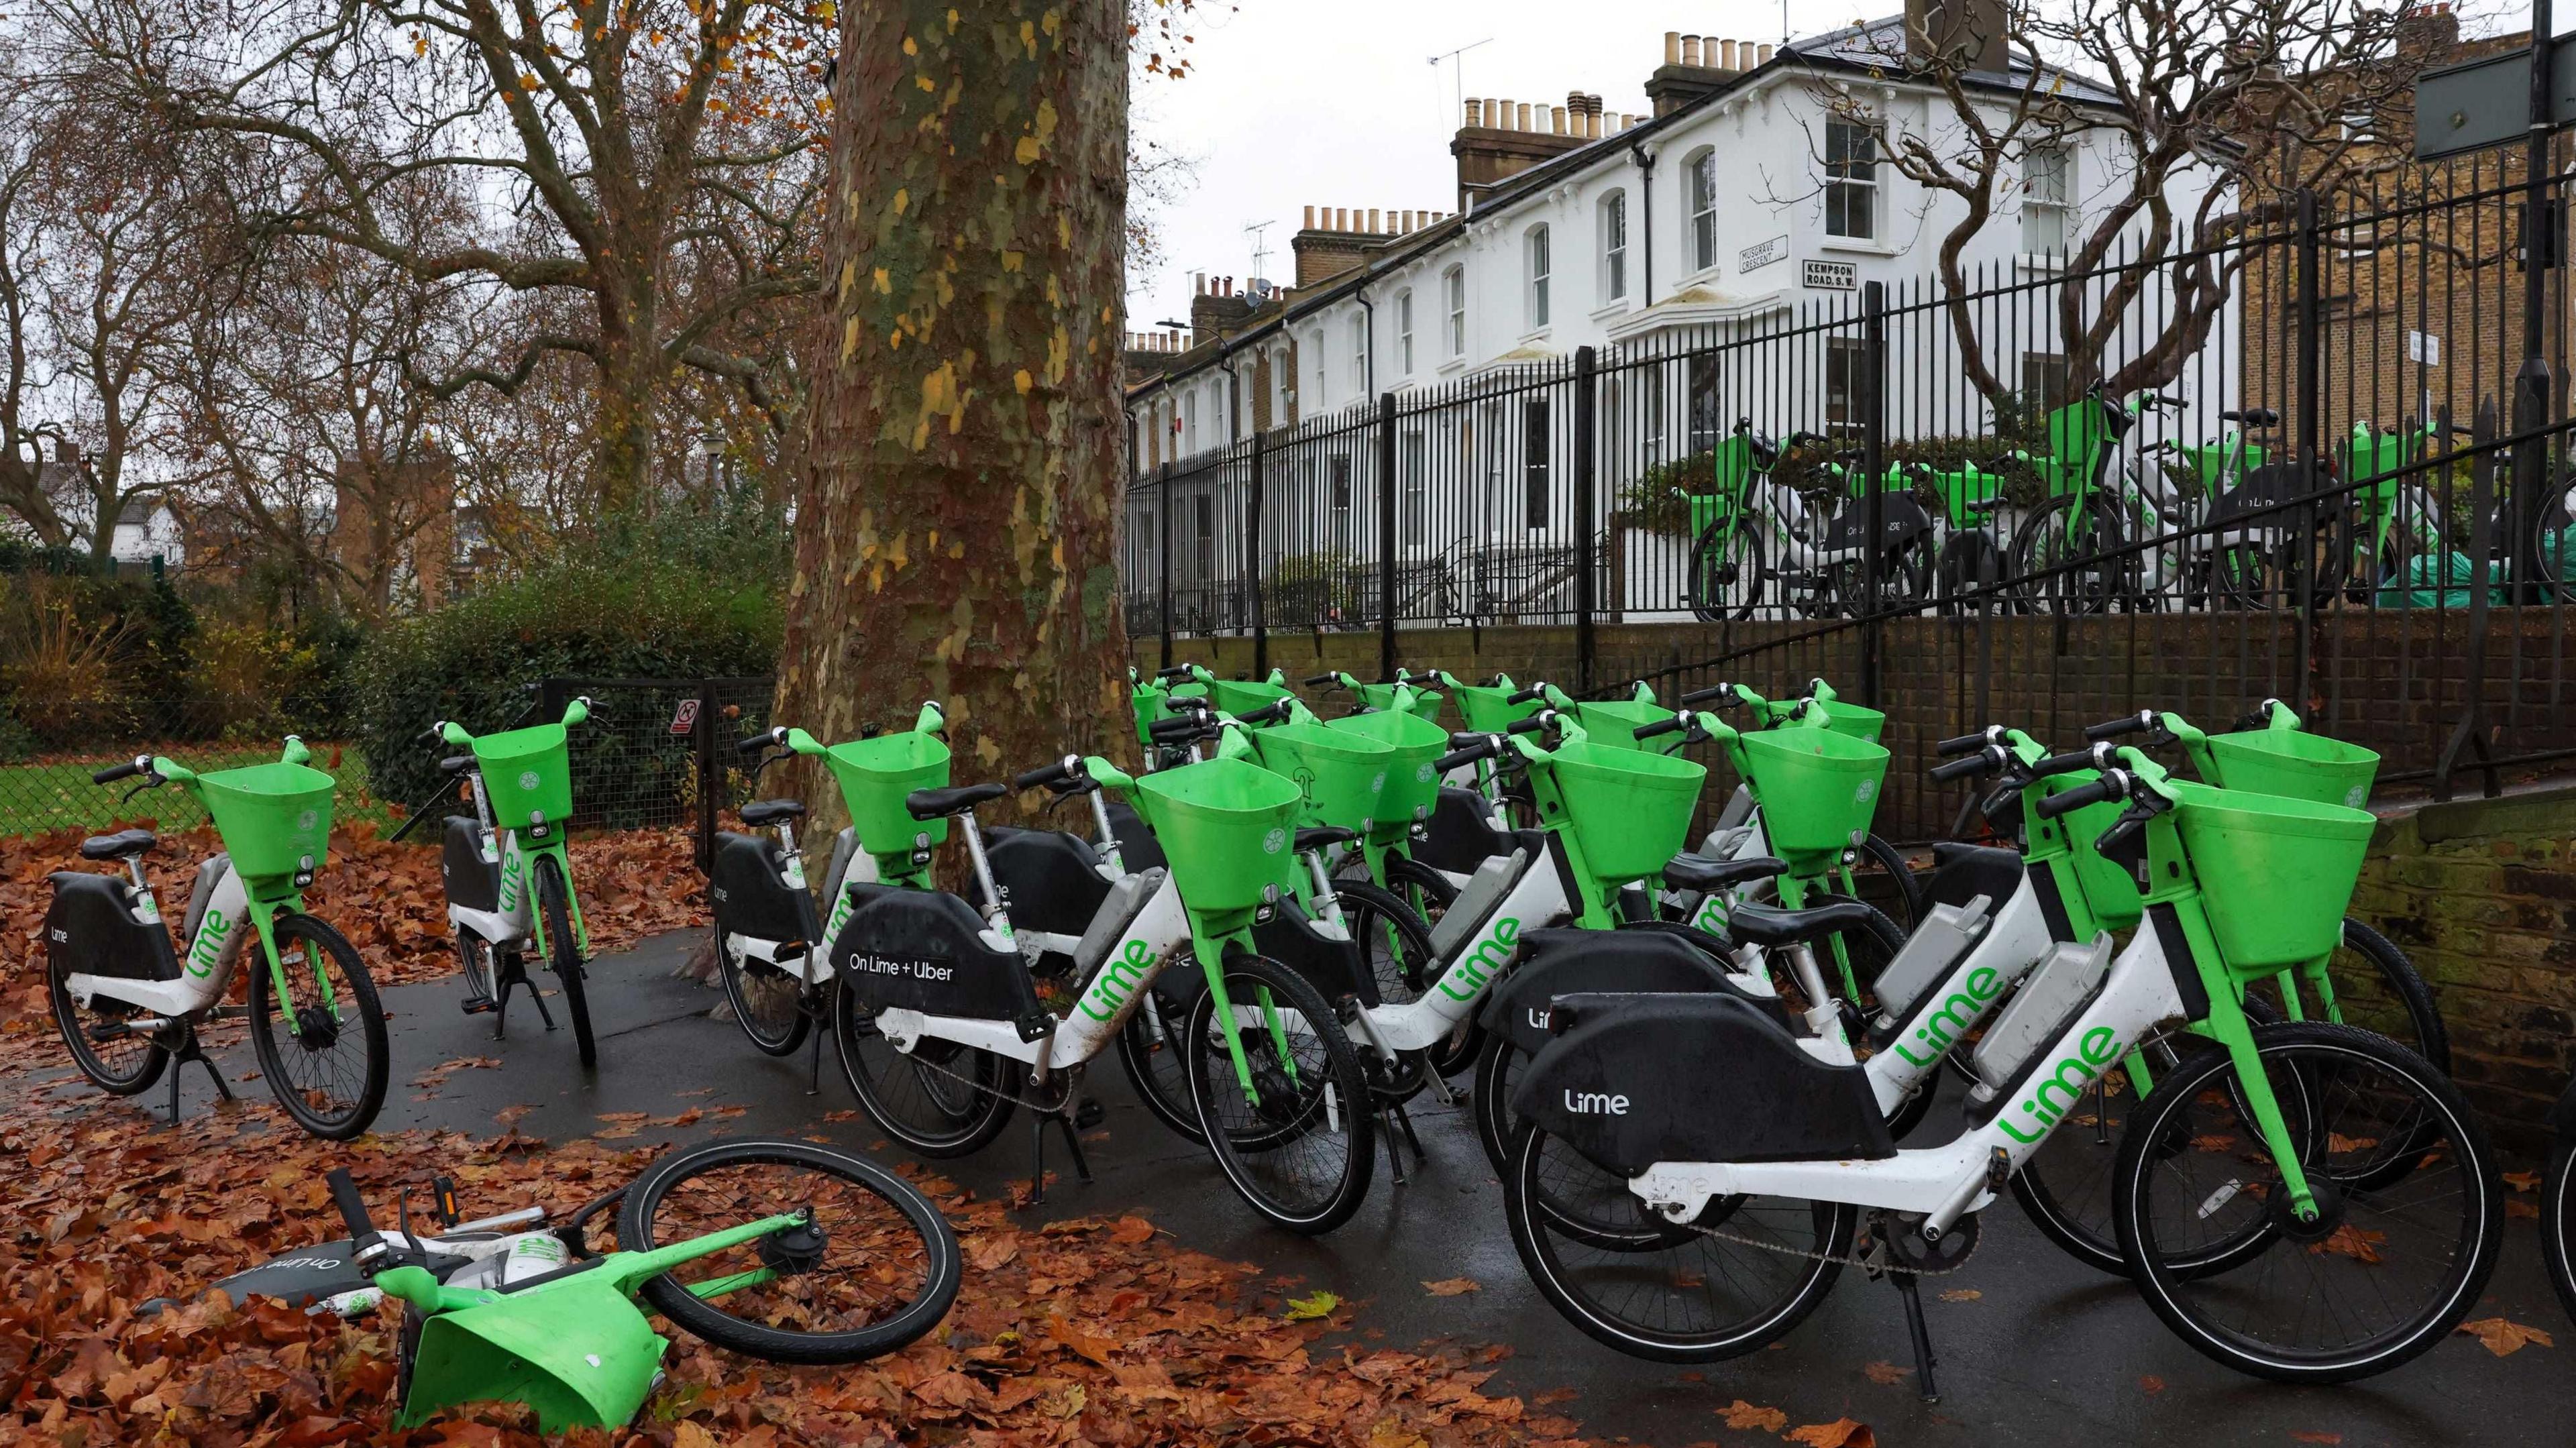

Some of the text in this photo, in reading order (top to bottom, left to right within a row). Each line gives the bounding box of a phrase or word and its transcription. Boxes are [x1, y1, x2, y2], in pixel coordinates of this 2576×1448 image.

[1741, 241, 1774, 261] MUSGRAVE
[1741, 252, 1772, 270] CRESCENT
[1807, 263, 1852, 276] KEMPSON
[499, 852, 521, 912] Lime
[52, 926, 68, 943] Lime
[186, 909, 231, 979] Lime
[849, 953, 953, 981] On Lime + Uber
[1438, 916, 1520, 1002] Lime
[1078, 938, 1157, 1022] Lime
[1894, 966, 2004, 1067] Lime
[1996, 1025, 2122, 1144] Lime
[1565, 1089, 1629, 1115] Lime
[309, 1258, 341, 1270] On
